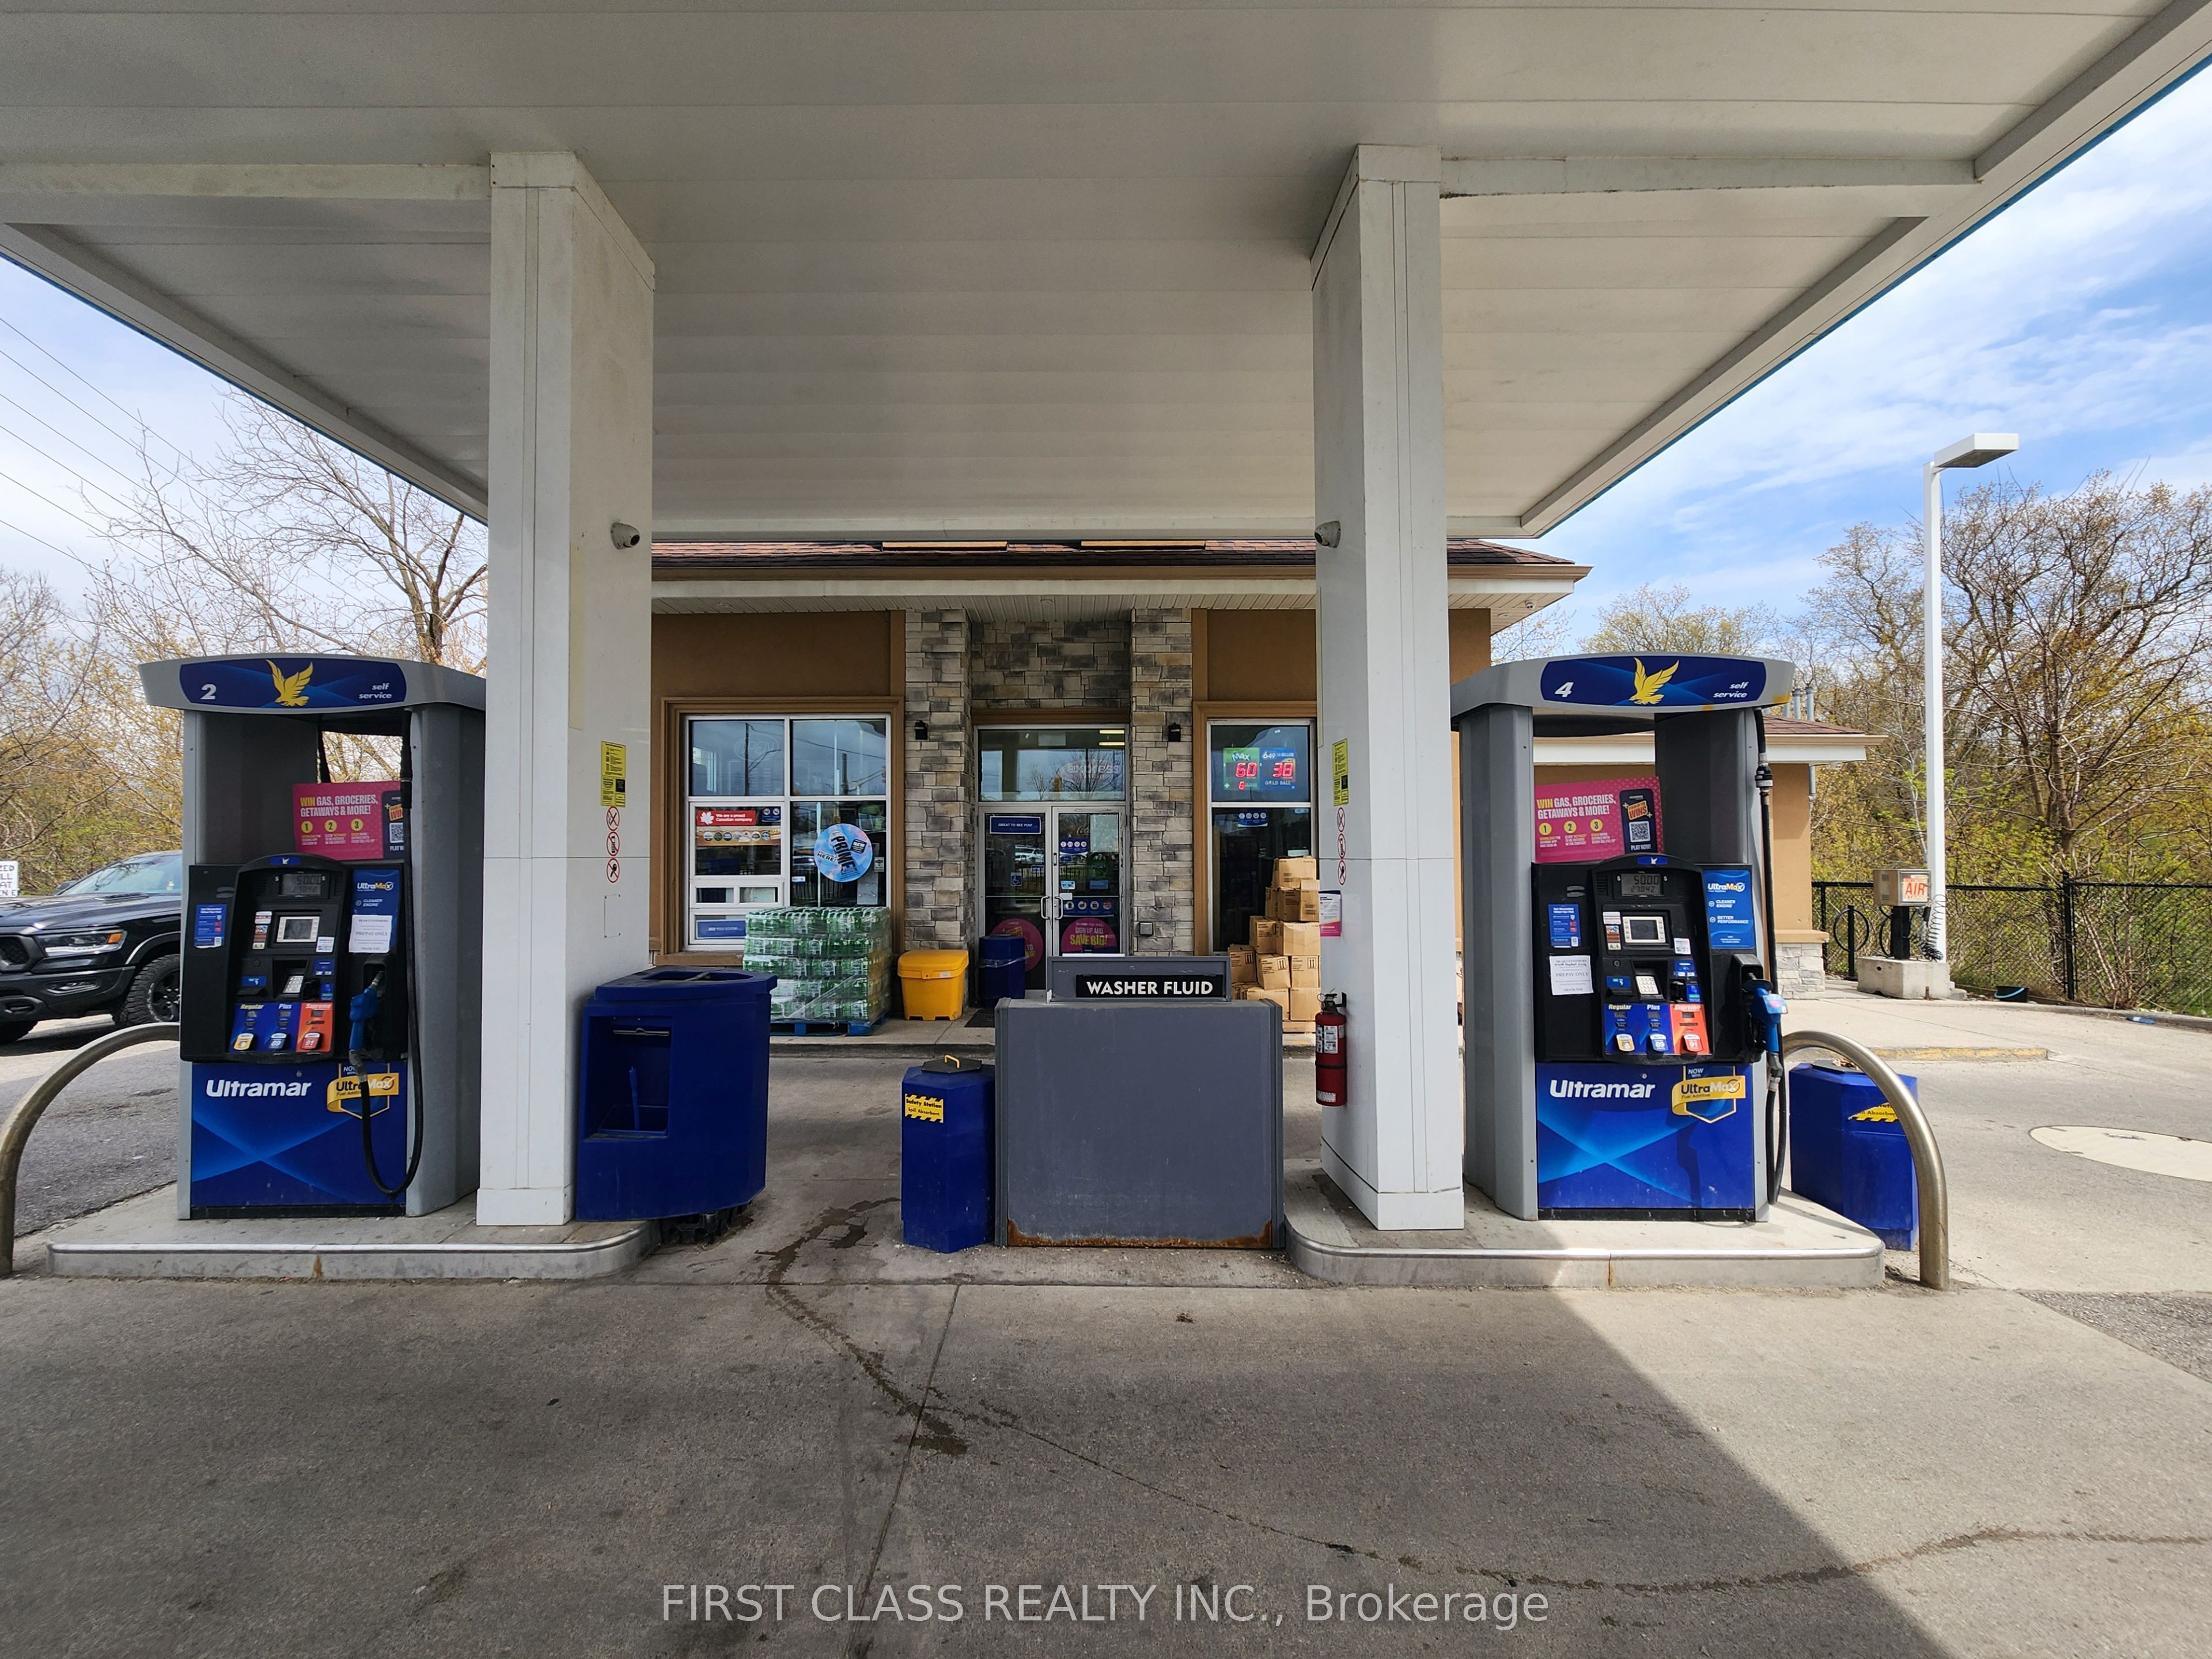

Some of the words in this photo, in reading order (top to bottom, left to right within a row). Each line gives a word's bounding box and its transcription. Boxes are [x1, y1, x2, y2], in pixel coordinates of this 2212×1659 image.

[200, 684, 217, 699] 2
[1554, 682, 1574, 697] 4
[737, 741, 775, 755] OPEN
[1232, 752, 1251, 761] MAX
[1235, 762, 1257, 777] 60
[300, 797, 316, 806] WIN
[316, 796, 334, 806] GAS,
[335, 794, 378, 805] GROCERIES,
[1537, 799, 1553, 809] WIN
[1554, 798, 1572, 808] GAS,
[1572, 794, 1616, 806] GROCERIES,
[301, 807, 339, 817] GETAWAYS
[340, 807, 346, 815] &
[347, 805, 371, 815] MORE!
[390, 808, 403, 819] WIN
[1537, 808, 1578, 819] GETAWAYS
[1579, 807, 1585, 816] &
[1585, 805, 1609, 816] MORE!
[1629, 805, 1647, 819] WINS
[817, 853, 838, 863] HERE!
[831, 836, 857, 873] PRIME
[357, 882, 393, 891] UltraMax
[1634, 875, 1659, 885] 50.00
[1707, 882, 1745, 892] UltraMax
[1905, 882, 1926, 895] AIR
[1070, 934, 1090, 945] SAVE
[1090, 934, 1108, 945] BIG!
[1086, 981, 1158, 995] WASHER
[1164, 981, 1213, 995] FLUID
[206, 1079, 312, 1097] Ultramar
[1550, 1080, 1656, 1098] Ultramar
[1681, 1080, 1740, 1094] UltraMax
[906, 1099, 922, 1107] Safety
[923, 1100, 942, 1109] Station
